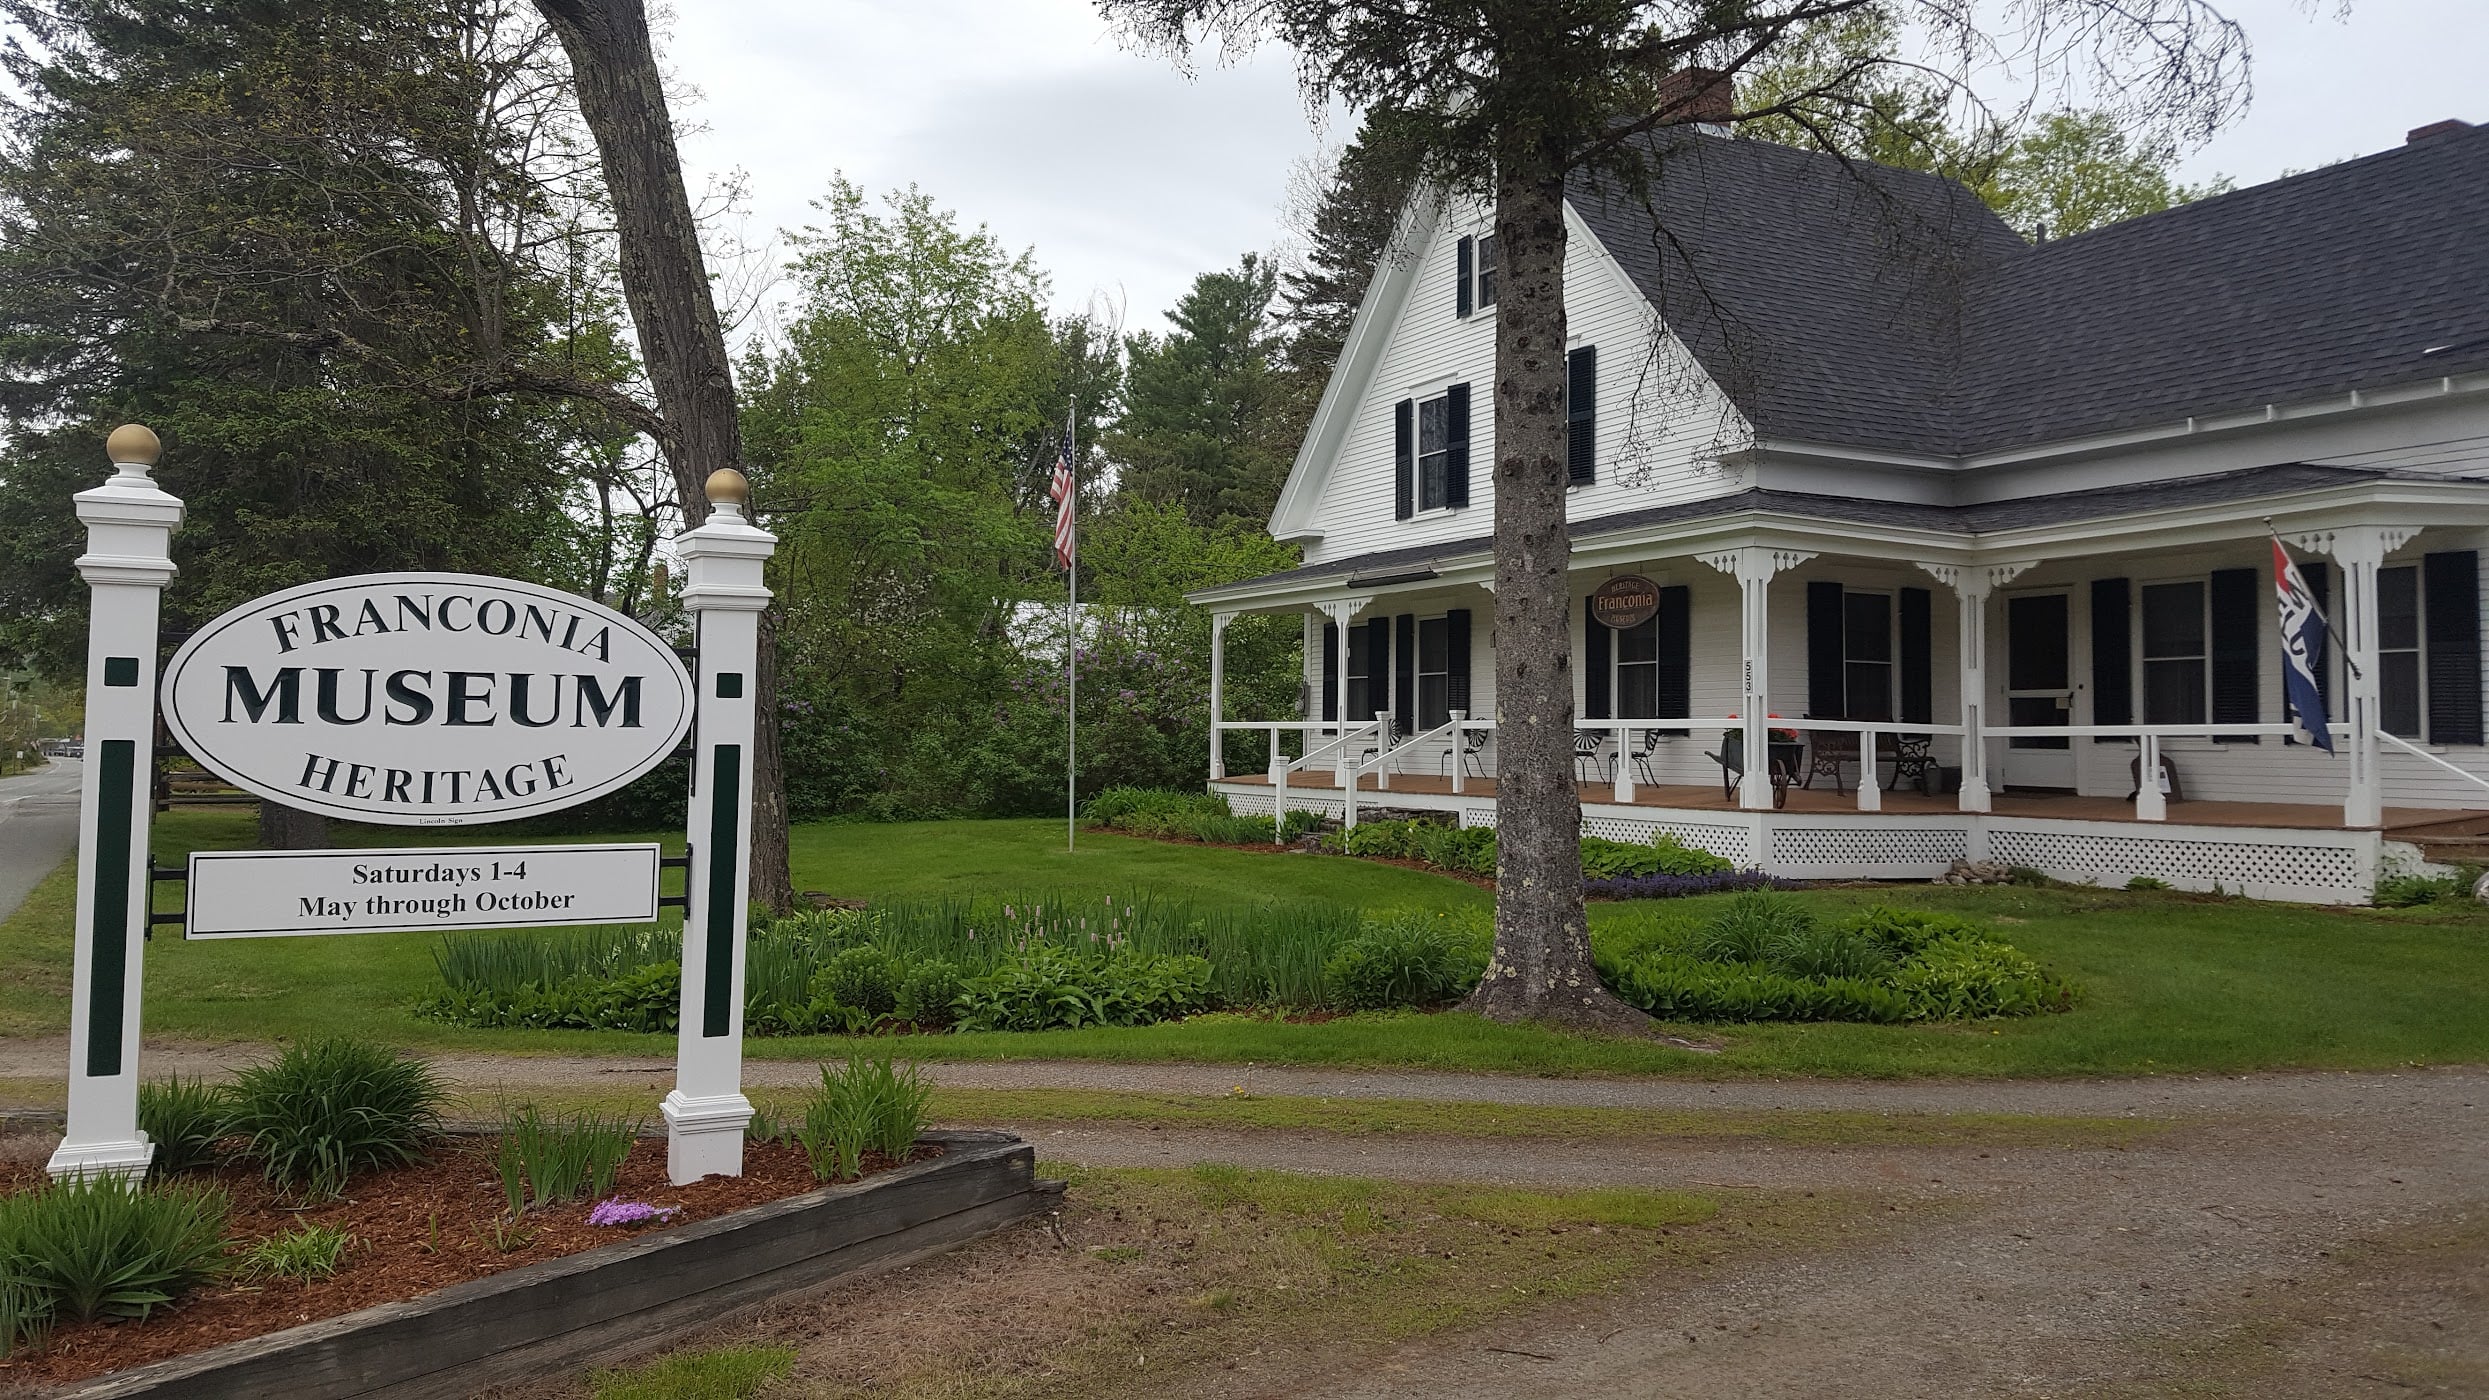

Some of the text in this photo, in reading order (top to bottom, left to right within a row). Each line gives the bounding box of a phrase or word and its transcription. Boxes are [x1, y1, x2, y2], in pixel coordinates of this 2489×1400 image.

[1598, 592, 1653, 611] Franconia
[266, 594, 612, 663] FRANCONIA
[217, 665, 646, 728] MUSEUM
[296, 752, 575, 804] HERITAGE
[419, 817, 446, 825] Lincoln
[352, 860, 527, 887] Saturdays 1-4
[299, 890, 575, 921] May through October
